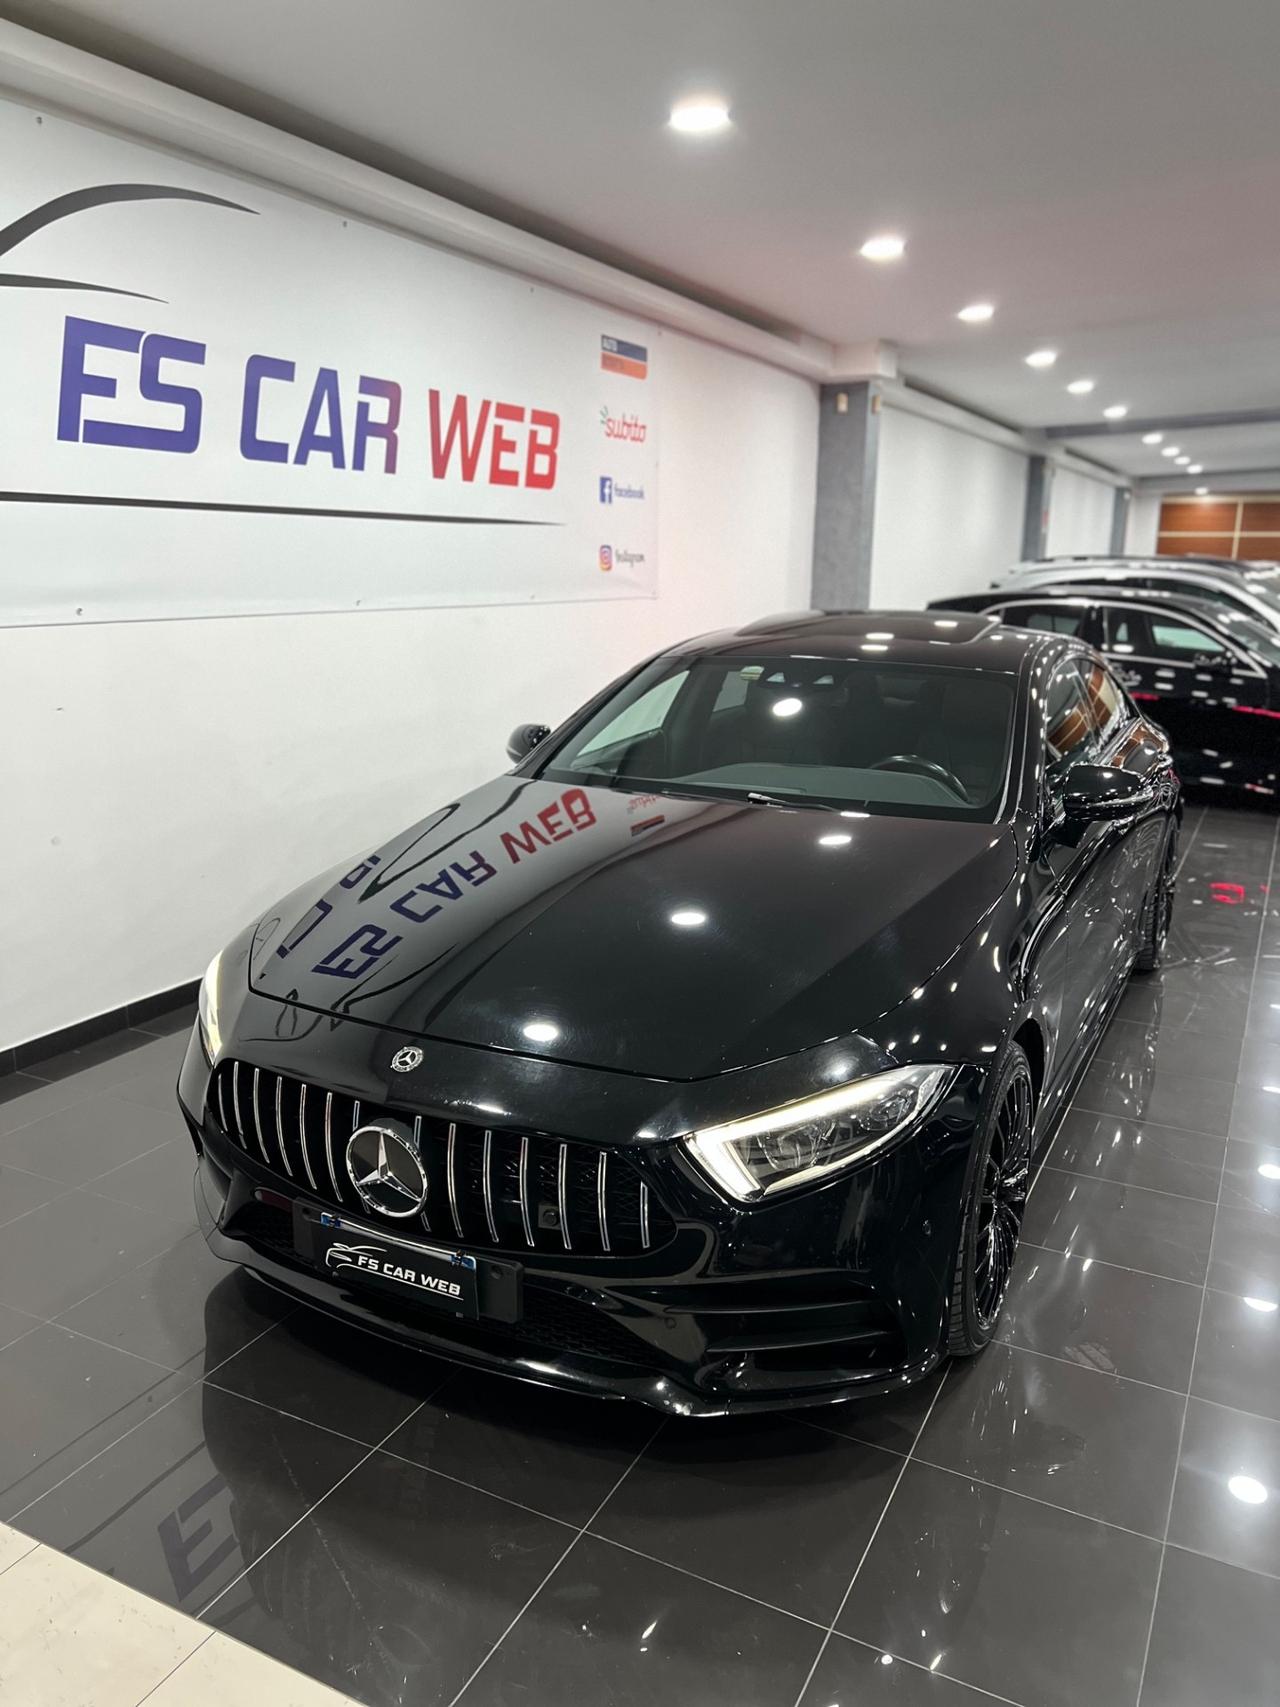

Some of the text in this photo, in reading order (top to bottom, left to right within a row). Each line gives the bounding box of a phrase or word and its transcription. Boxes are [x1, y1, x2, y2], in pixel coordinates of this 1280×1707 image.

[240, 354, 401, 474] CAR
[428, 389, 560, 490] WEB
[605, 412, 646, 443] subito
[358, 1255, 461, 1296] FS CAR WEB
